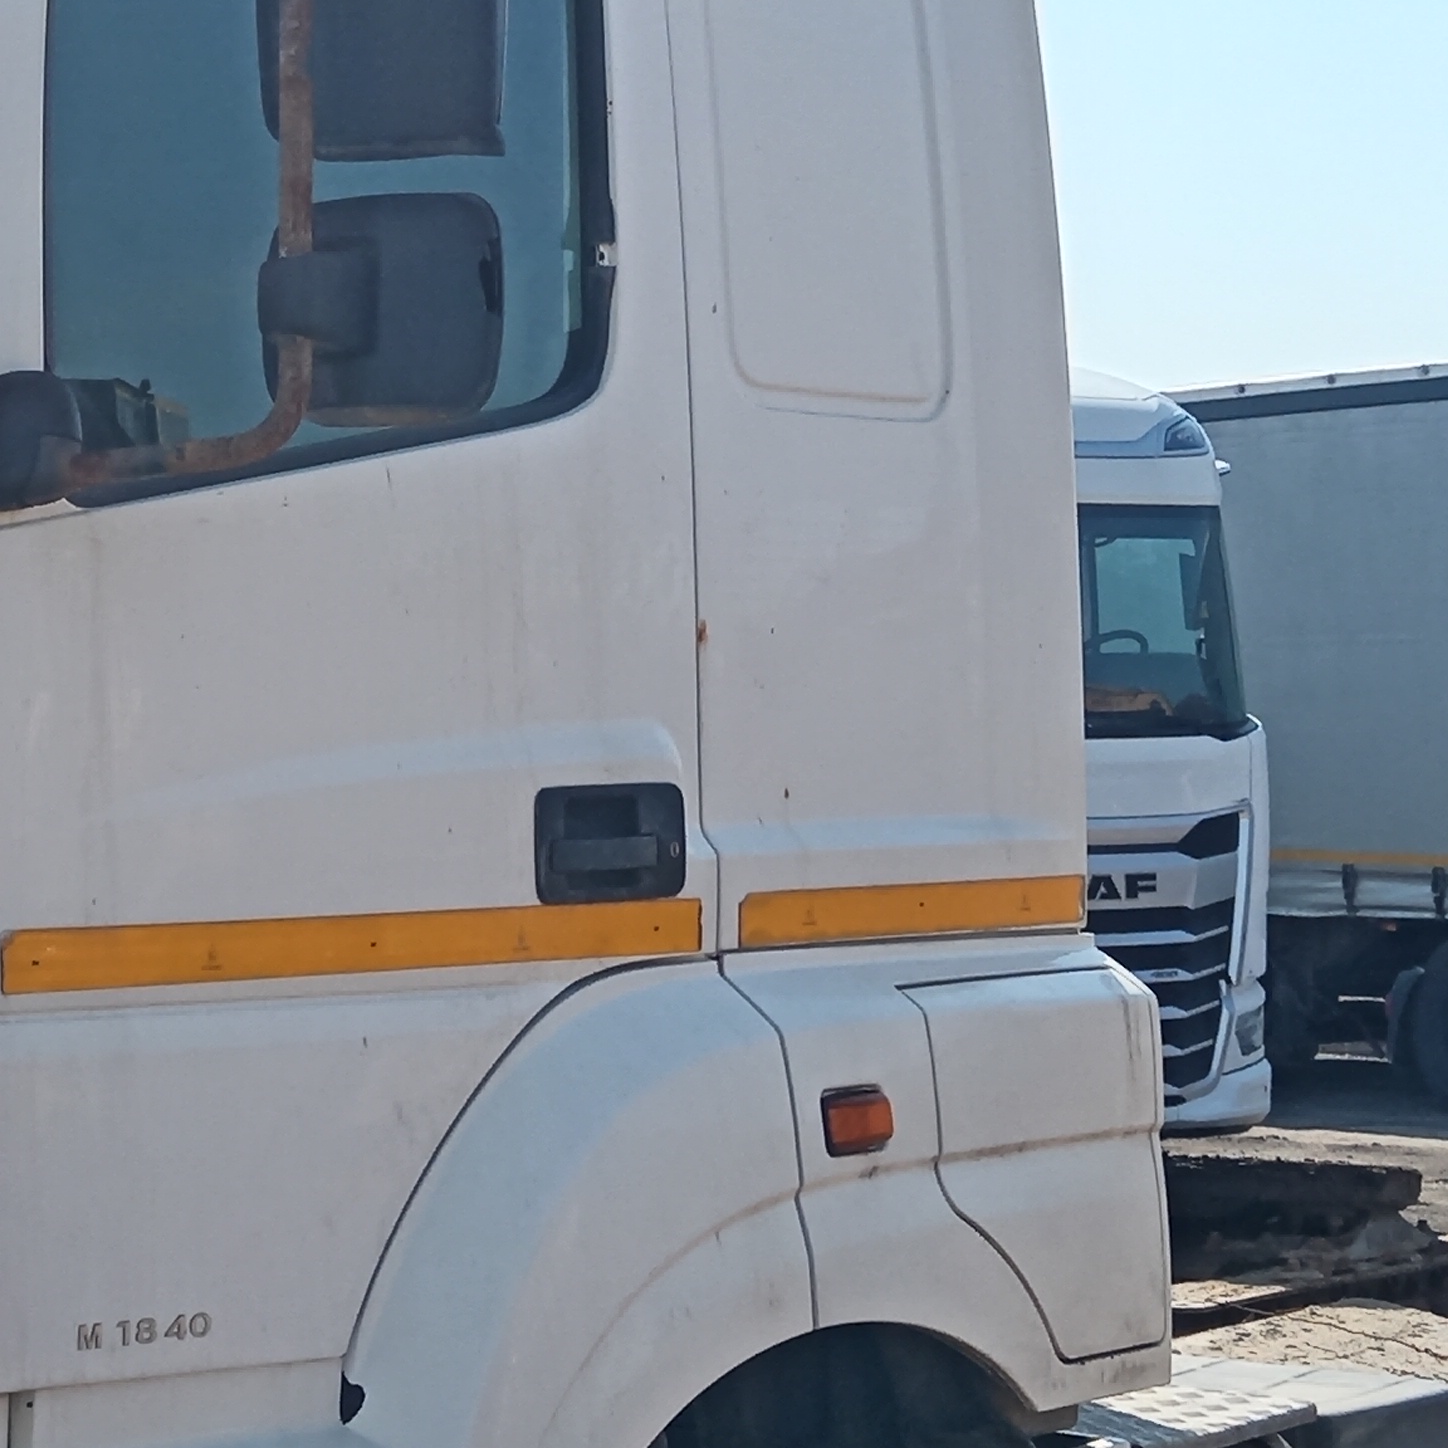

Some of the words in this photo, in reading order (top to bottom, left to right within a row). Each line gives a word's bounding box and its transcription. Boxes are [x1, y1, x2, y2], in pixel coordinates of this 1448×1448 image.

[1087, 871, 1158, 902] AF
[76, 1321, 104, 1352] M
[115, 1310, 213, 1348] 1840
